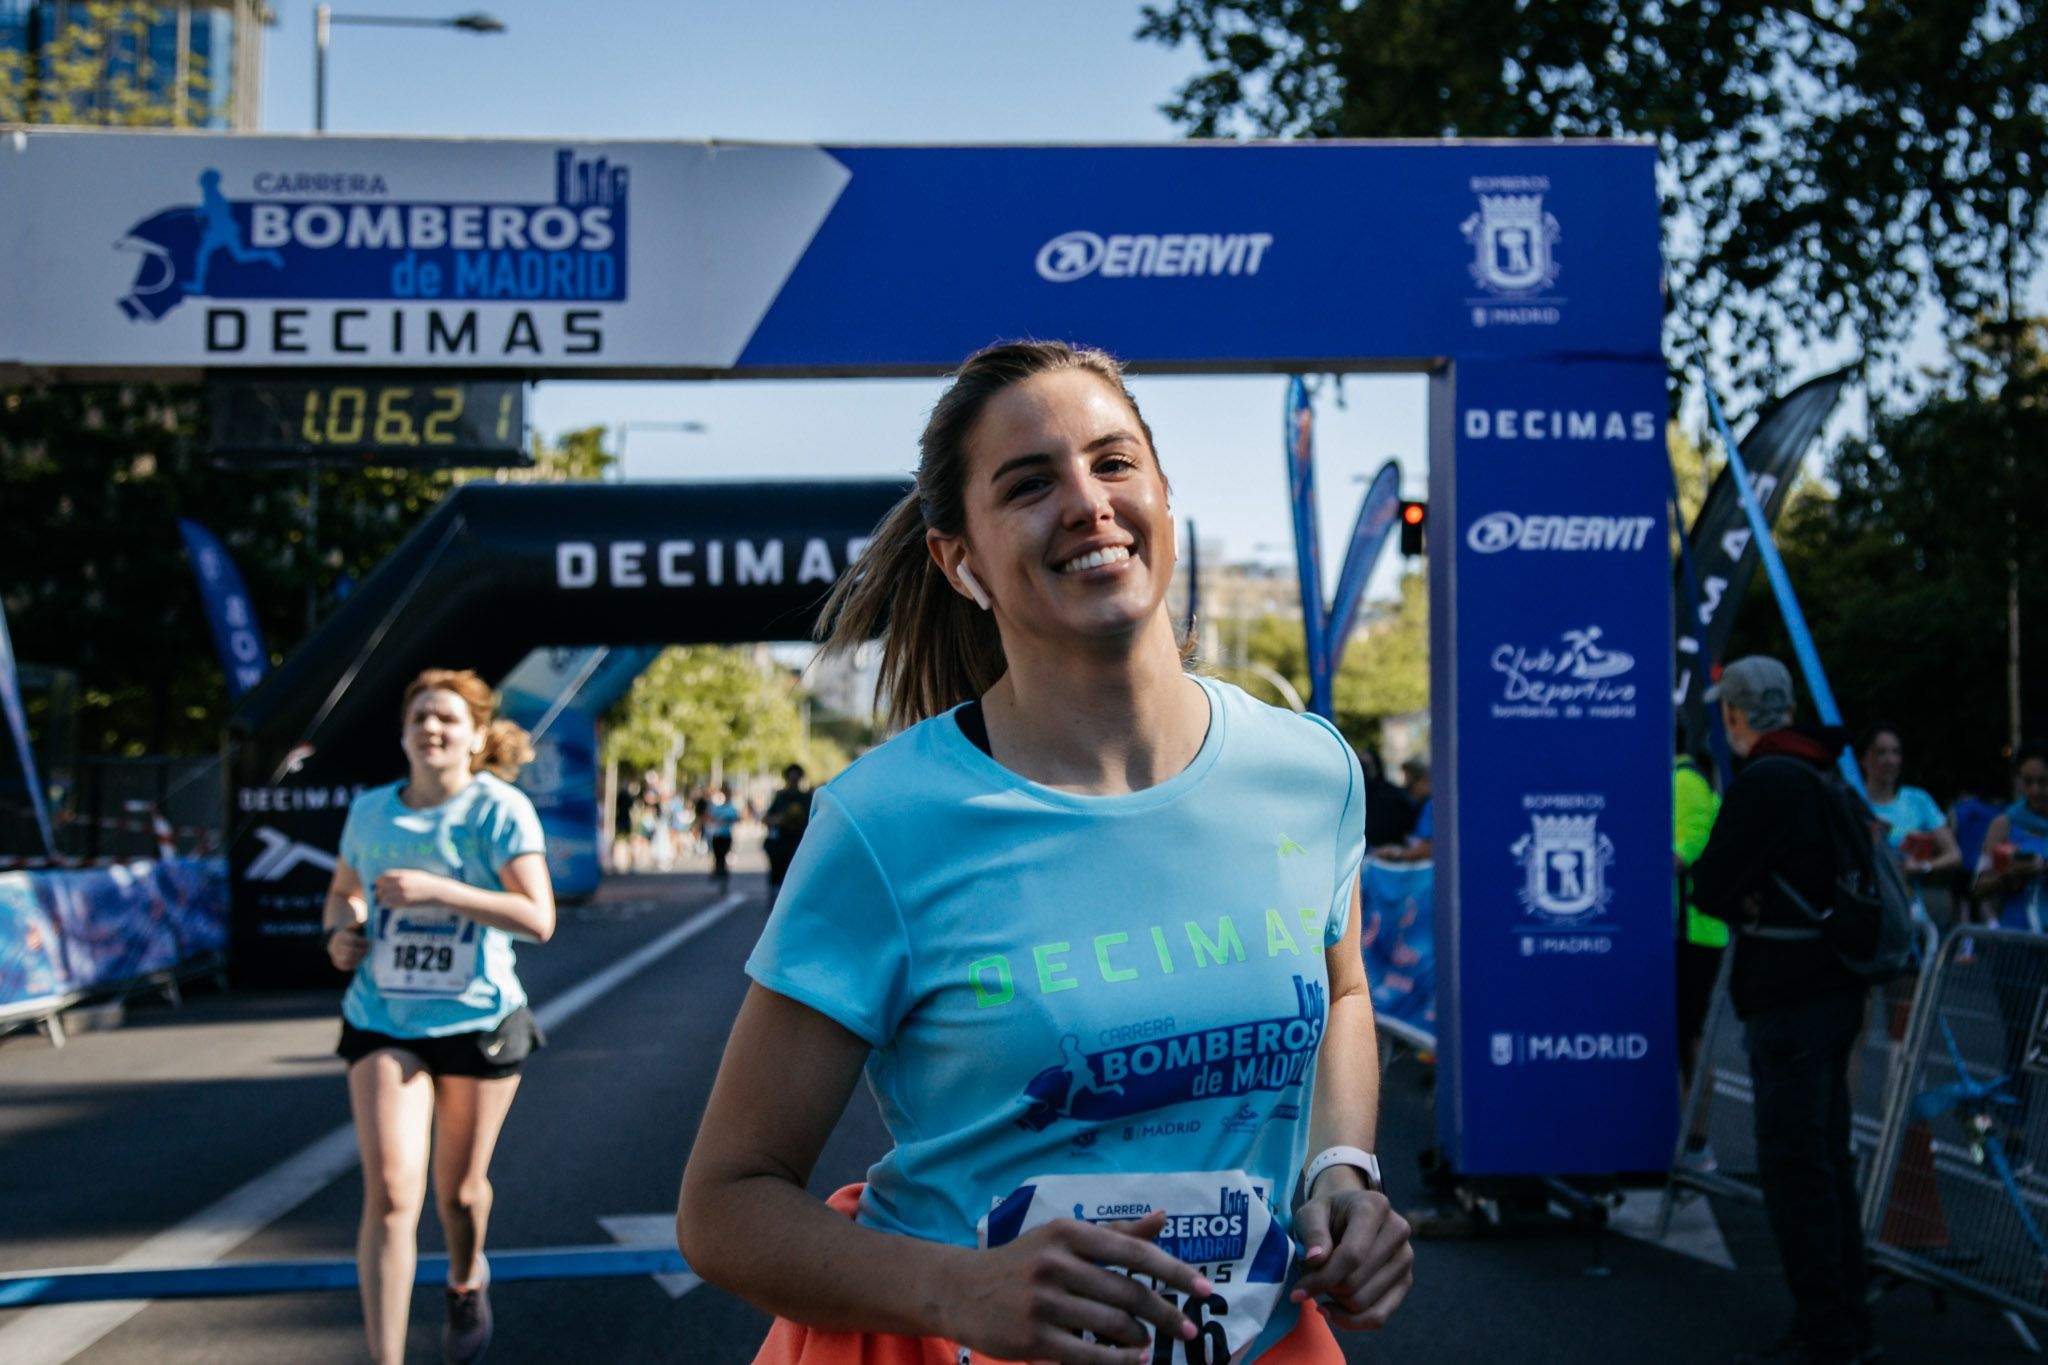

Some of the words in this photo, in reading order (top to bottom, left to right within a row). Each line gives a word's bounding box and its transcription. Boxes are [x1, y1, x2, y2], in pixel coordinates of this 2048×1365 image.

[253, 172, 388, 196] CARRERA
[251, 205, 616, 251] BOMBEROS
[391, 250, 442, 298] de
[456, 251, 616, 298] MADRID
[207, 308, 604, 354] DECIMAS
[1464, 409, 1656, 441] DECIMAS
[1522, 794, 1606, 811] BOMBEROS
[393, 945, 453, 973] 1829
[1543, 936, 1613, 954] MADRID
[1100, 1017, 1176, 1048] CARRERA
[1102, 1018, 1321, 1083] BOMBEROS
[1528, 1033, 1649, 1061] MADRID
[1192, 1065, 1225, 1097] de
[1143, 1119, 1201, 1138] MADRID
[1096, 1204, 1152, 1216] CARRERA
[1178, 1237, 1243, 1262] MADRID
